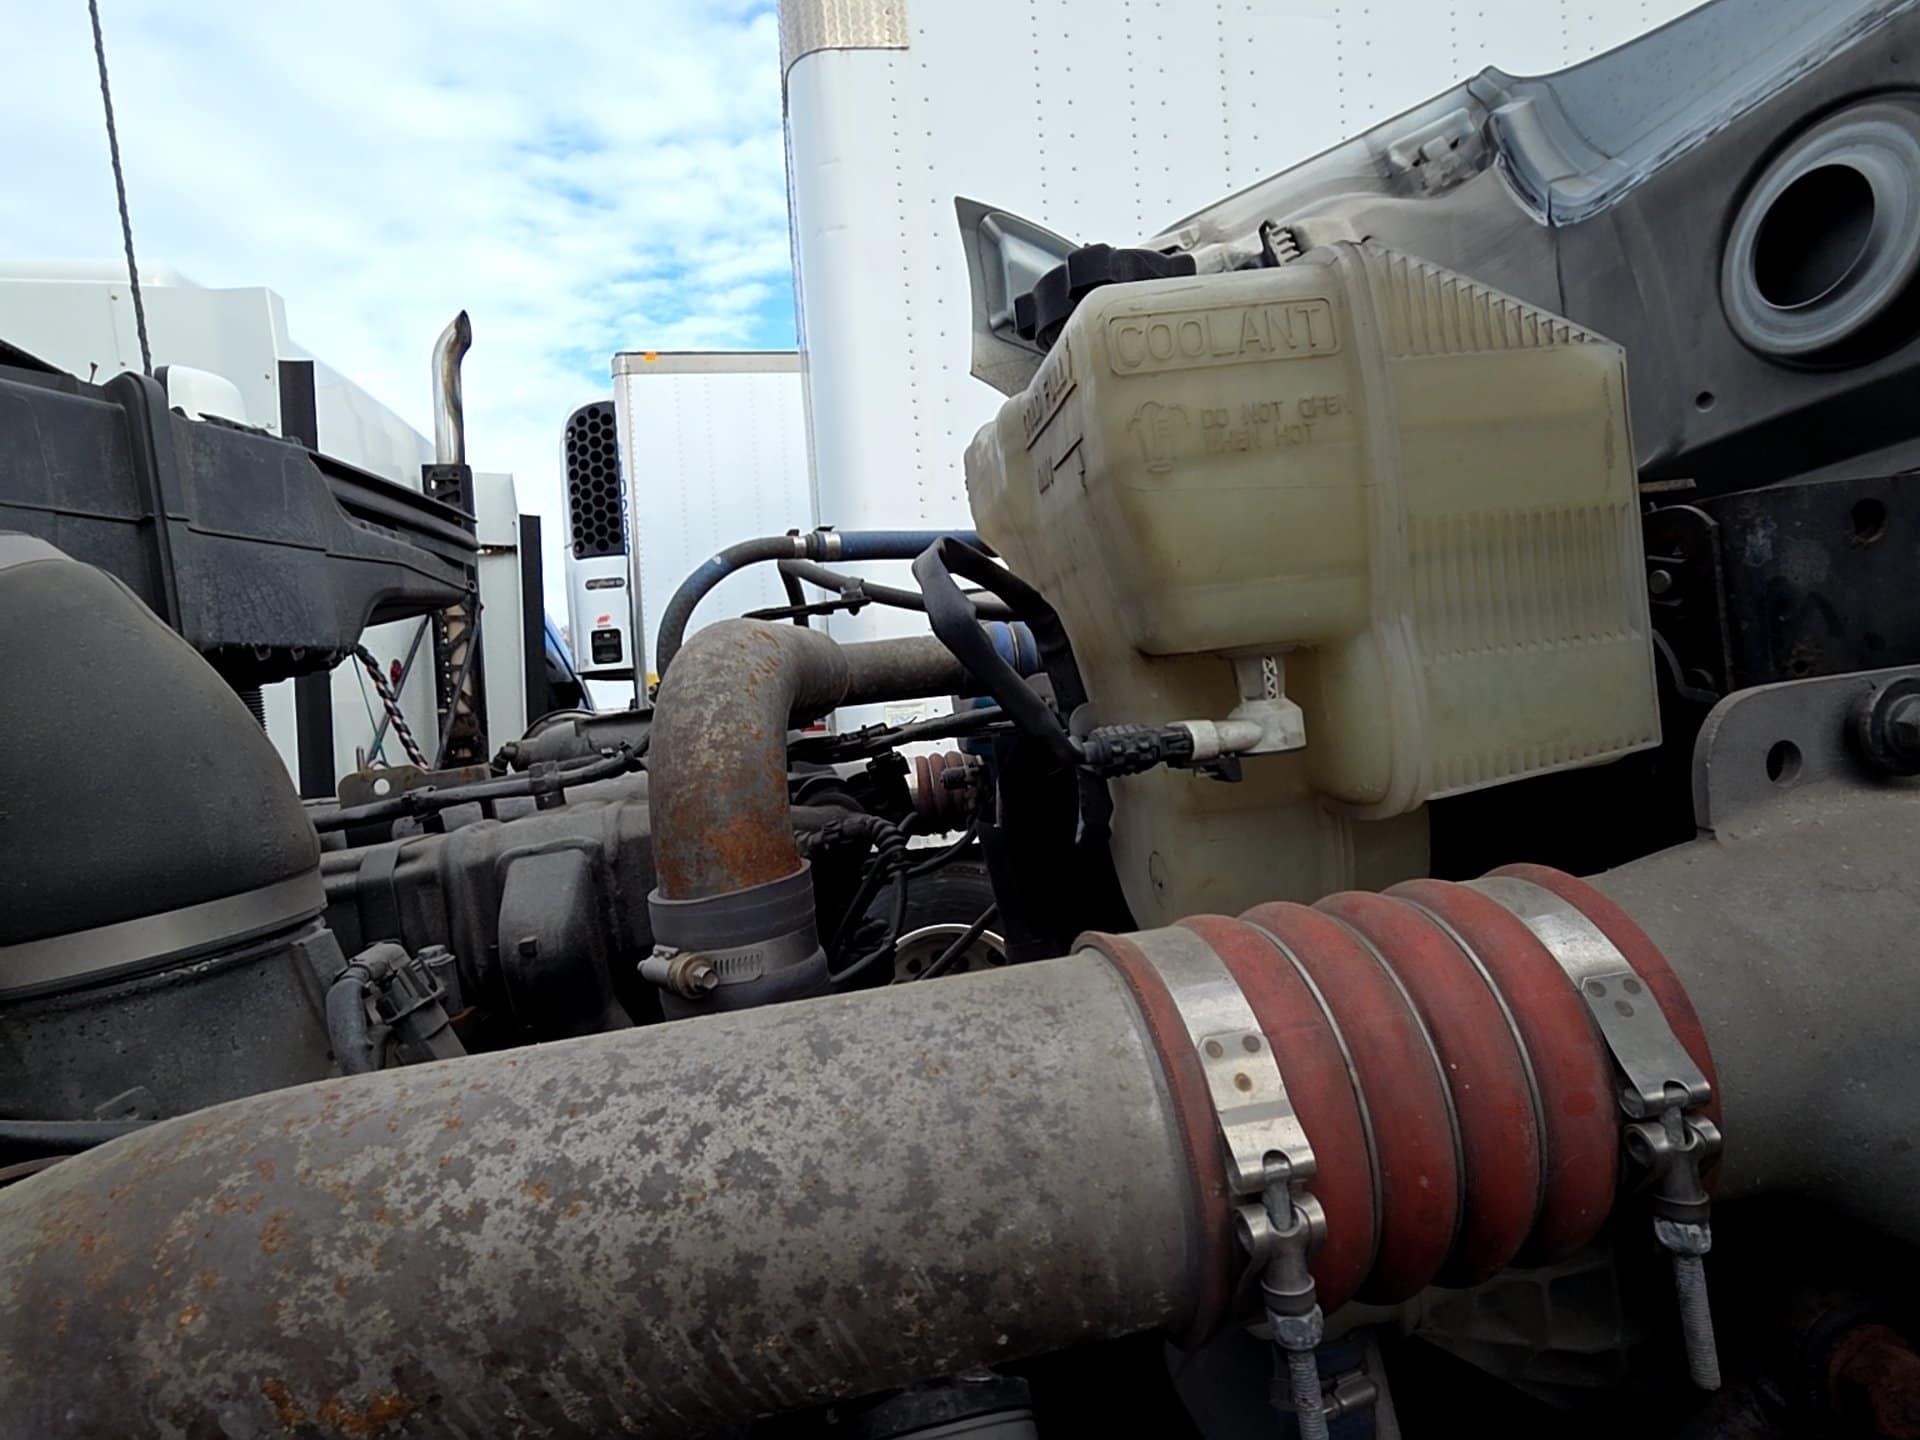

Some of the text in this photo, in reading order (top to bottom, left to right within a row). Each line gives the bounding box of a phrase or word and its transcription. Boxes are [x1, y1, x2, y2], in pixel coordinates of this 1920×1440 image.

[1115, 307, 1321, 369] COOLANT
[1200, 407, 1230, 431] DO
[1240, 400, 1284, 427] NOT
[1272, 421, 1316, 449] HOT
